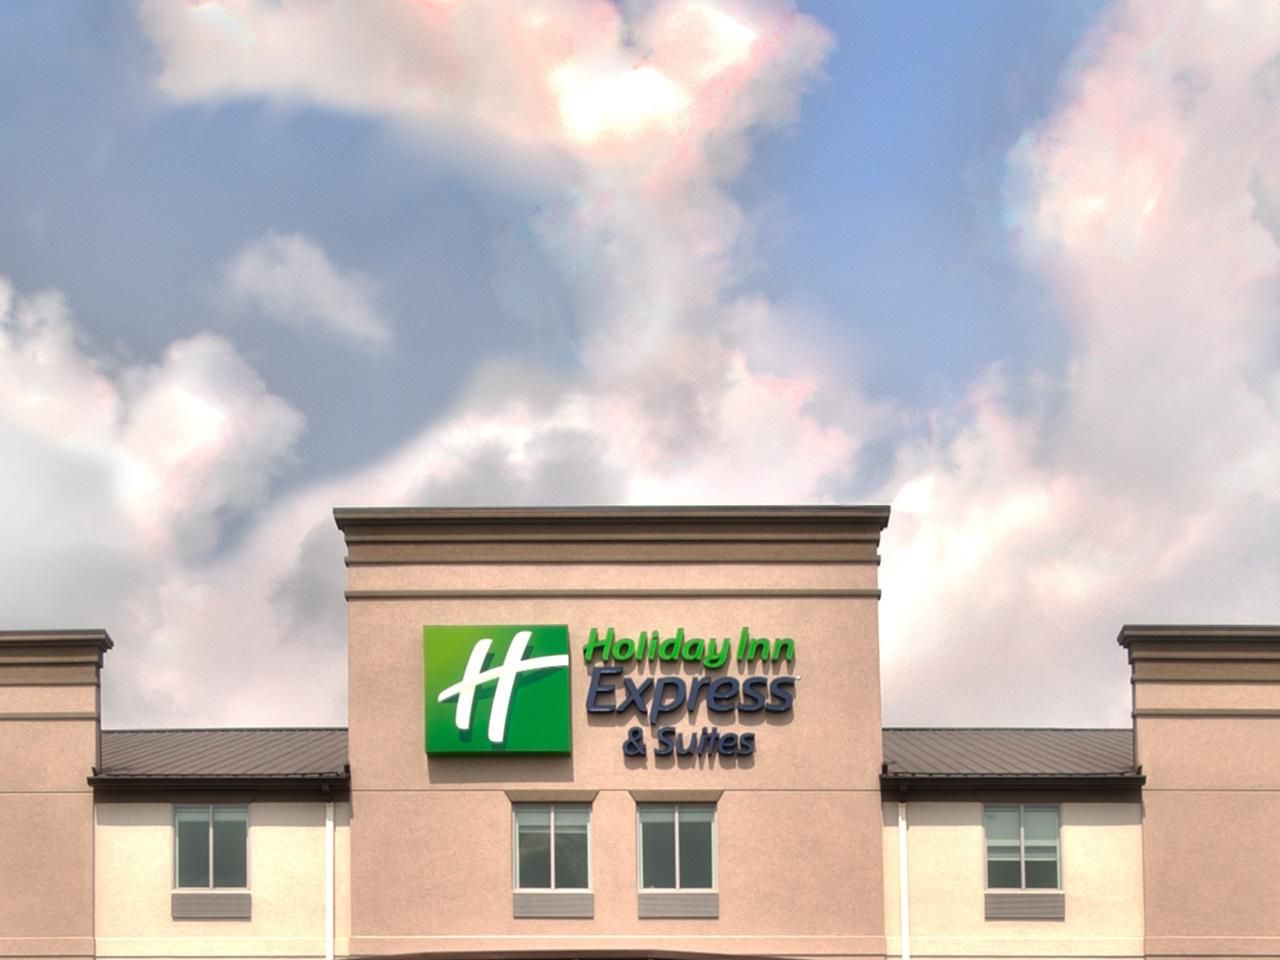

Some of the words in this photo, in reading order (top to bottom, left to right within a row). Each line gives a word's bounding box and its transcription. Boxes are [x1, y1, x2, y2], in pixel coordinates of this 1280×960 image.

[583, 627, 730, 668] Holiday
[737, 627, 795, 662] Inn
[437, 630, 569, 743] H
[585, 666, 796, 724] Express
[623, 728, 646, 756] &
[655, 726, 755, 757] Suites
